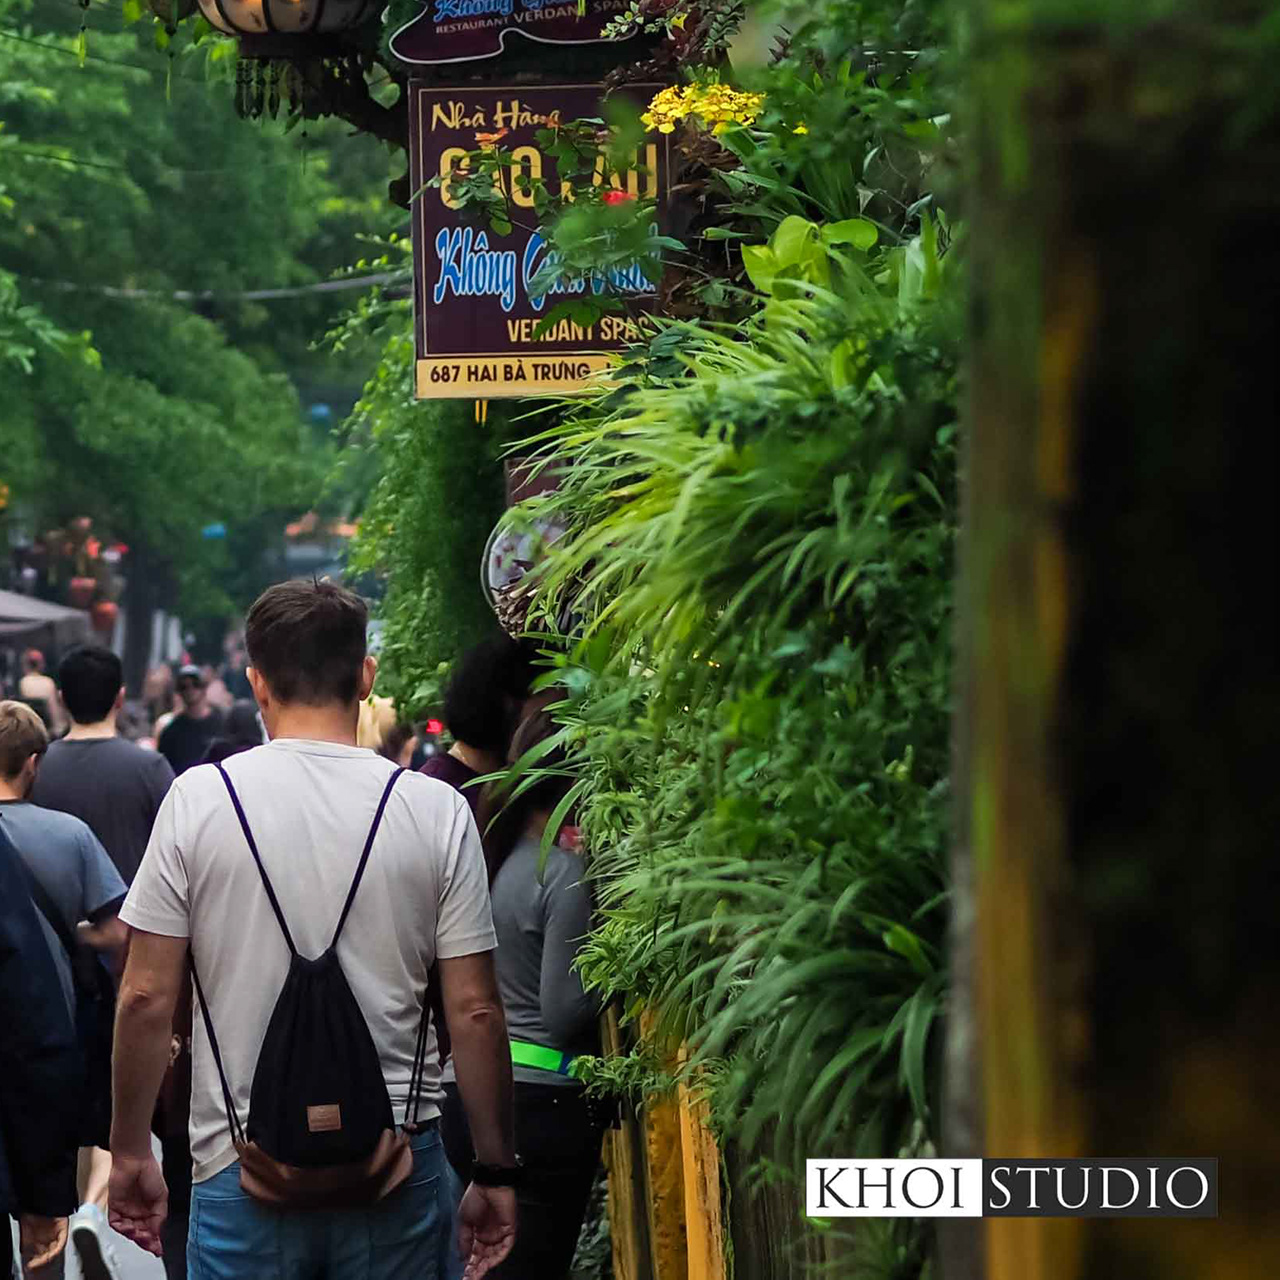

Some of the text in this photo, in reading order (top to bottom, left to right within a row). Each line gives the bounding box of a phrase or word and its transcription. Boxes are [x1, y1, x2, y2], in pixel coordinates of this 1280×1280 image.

[436, 17, 509, 34] RESTAURANT
[513, 5, 582, 24] VERDAN
[431, 100, 486, 131] Nhà
[433, 226, 517, 312] Không
[600, 317, 649, 341] SPAC
[430, 364, 460, 383] 687
[467, 363, 497, 382] HAI
[503, 358, 527, 381] BÀ
[532, 360, 591, 381] TRƯNG
